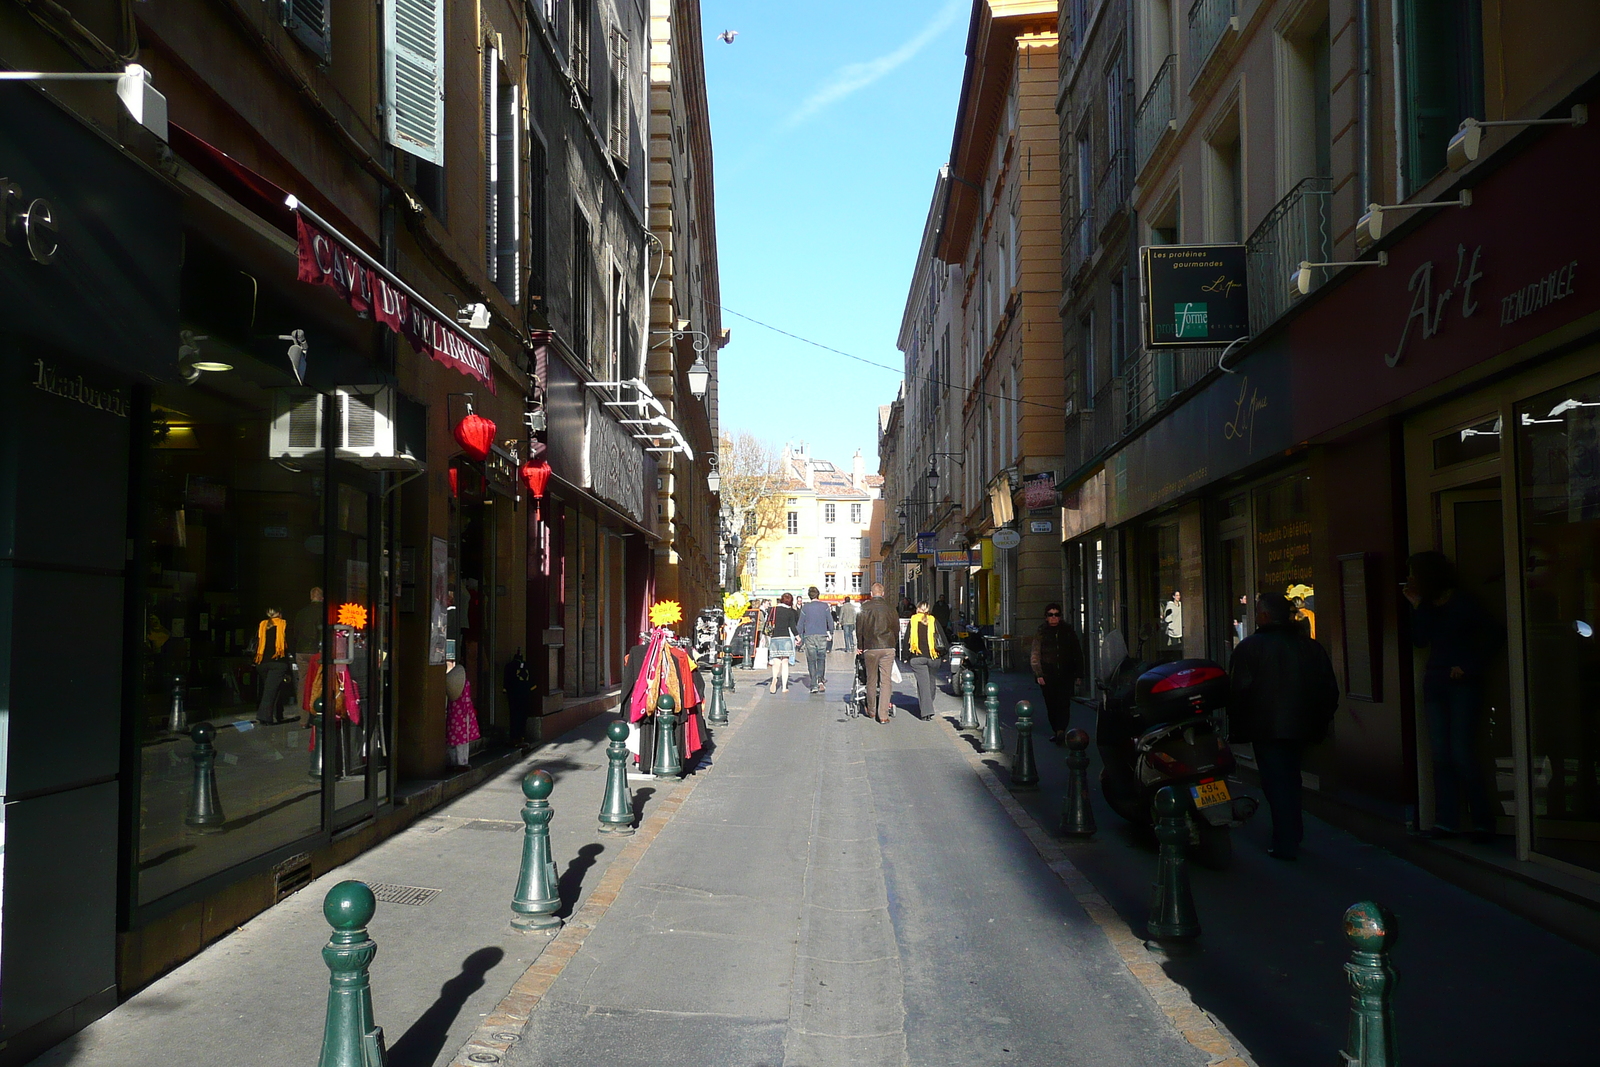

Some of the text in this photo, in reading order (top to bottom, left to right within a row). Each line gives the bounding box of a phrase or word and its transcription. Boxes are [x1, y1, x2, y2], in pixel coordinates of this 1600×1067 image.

[1153, 250, 1207, 259] Les protéines
[1172, 260, 1224, 269] gourmandes
[313, 234, 372, 303] CAVE
[378, 278, 408, 325] DU
[1500, 259, 1578, 328] TENDANCE
[1268, 549, 1282, 564] pour
[1201, 783, 1219, 794] 494
